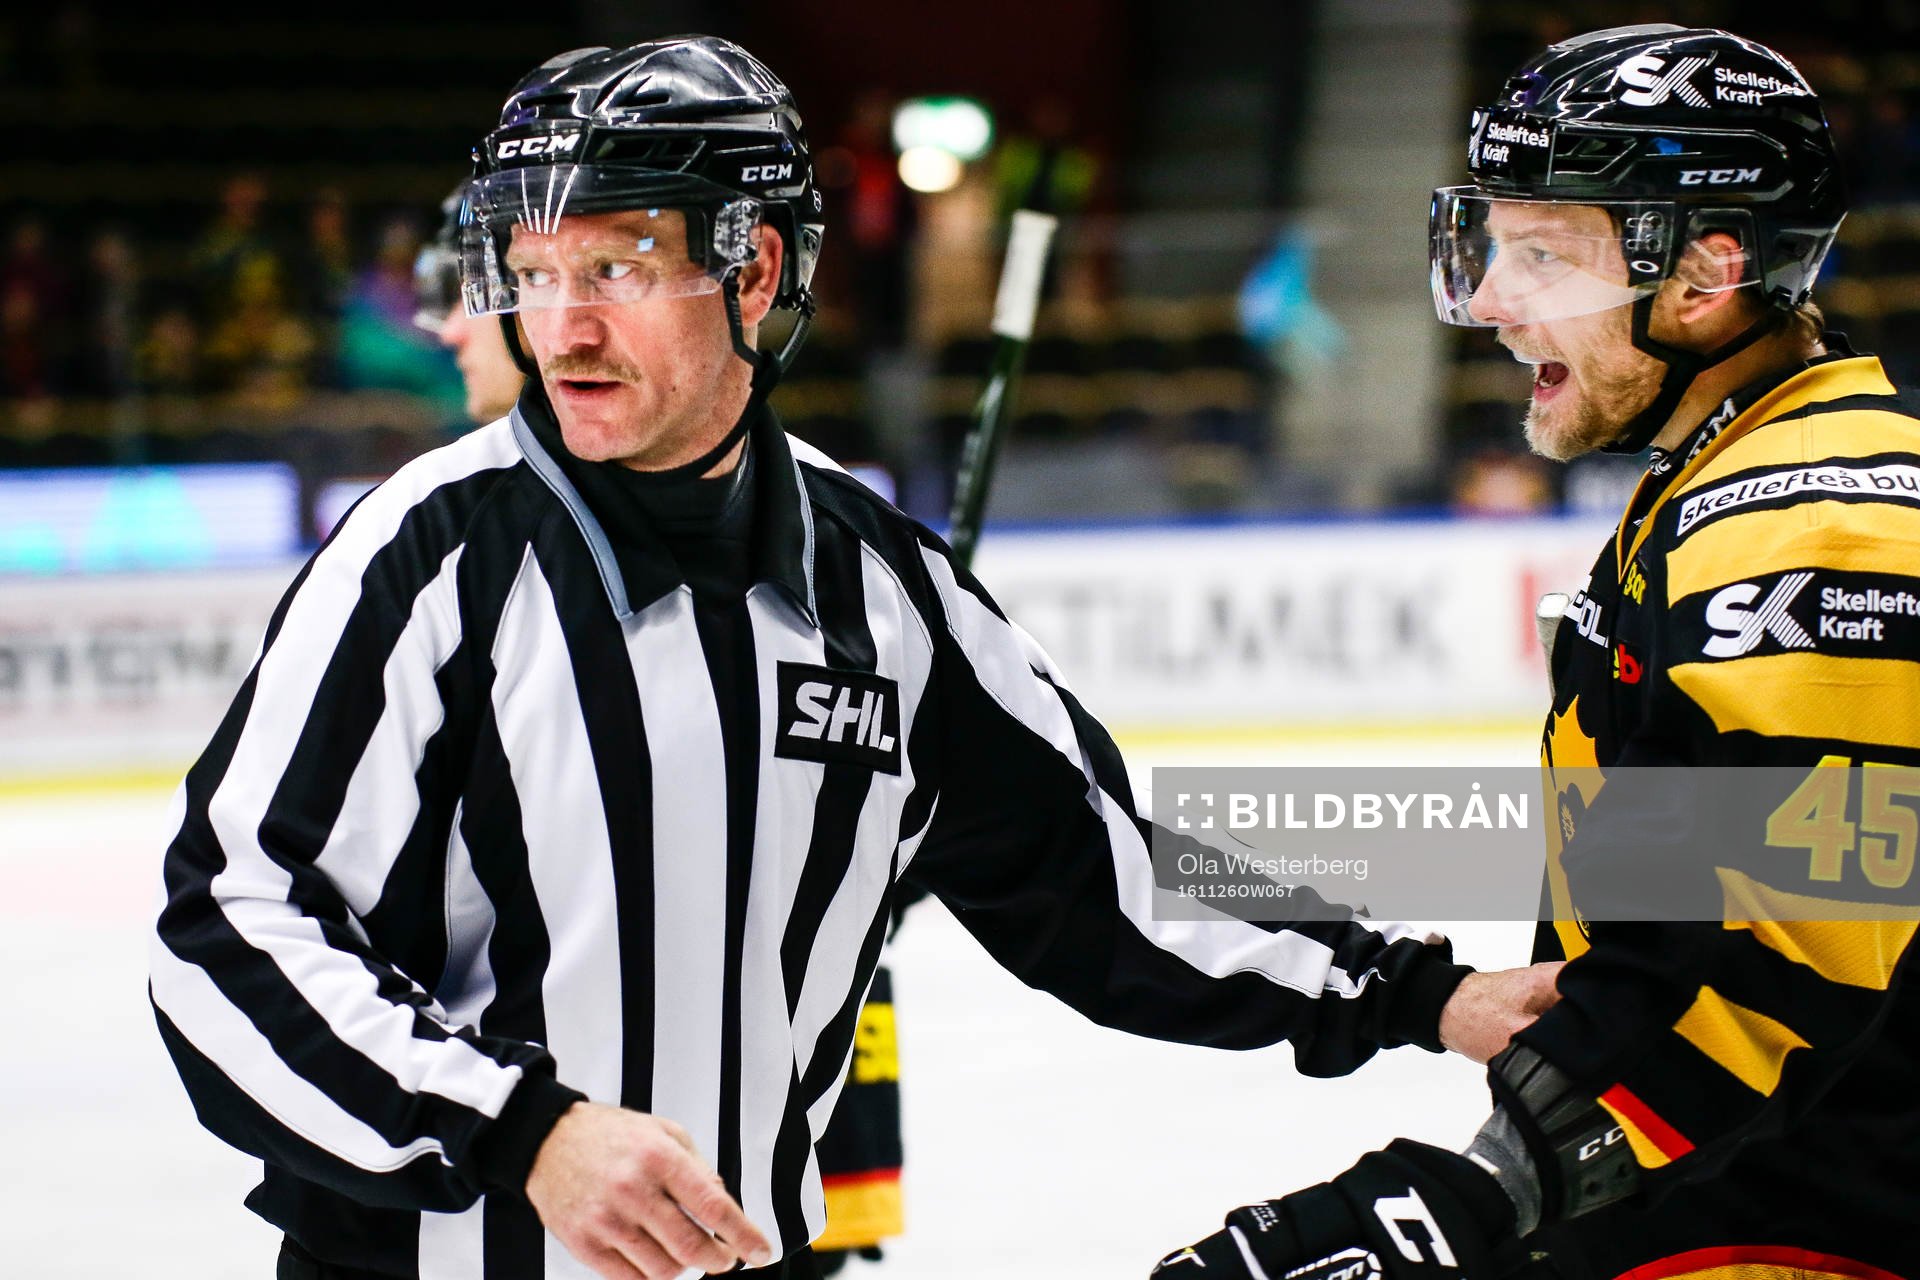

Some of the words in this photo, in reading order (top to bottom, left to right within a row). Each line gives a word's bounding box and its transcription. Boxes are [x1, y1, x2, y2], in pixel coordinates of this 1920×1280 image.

[1715, 86, 1763, 106] Kraft
[497, 133, 580, 160] CCM
[1487, 122, 1549, 148] Skellefteå
[1482, 143, 1510, 163] Kraft
[740, 163, 793, 183] CCM
[1679, 167, 1762, 186] CCM
[1682, 469, 1860, 528] skellefteå
[1702, 572, 1817, 658] SK
[1820, 615, 1885, 641] Kraft
[788, 681, 896, 752] SHL
[1764, 755, 1920, 888] 45
[1579, 1125, 1625, 1161] CC
